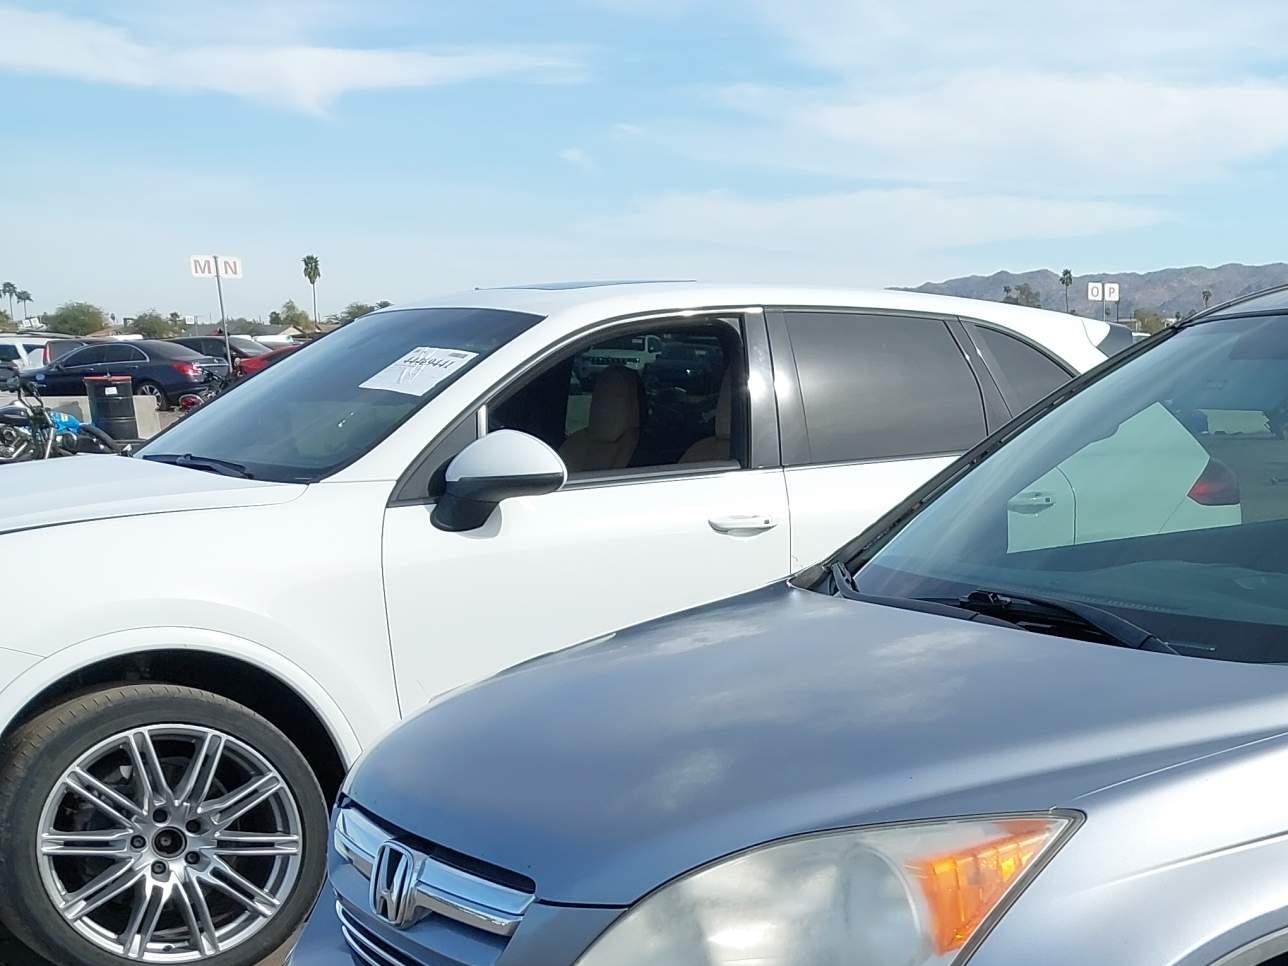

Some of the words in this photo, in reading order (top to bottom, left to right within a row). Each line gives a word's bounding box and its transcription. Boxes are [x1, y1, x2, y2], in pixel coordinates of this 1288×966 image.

[193, 259, 212, 275] M
[223, 260, 238, 275] N
[1091, 286, 1099, 297] O
[1108, 287, 1116, 297] P
